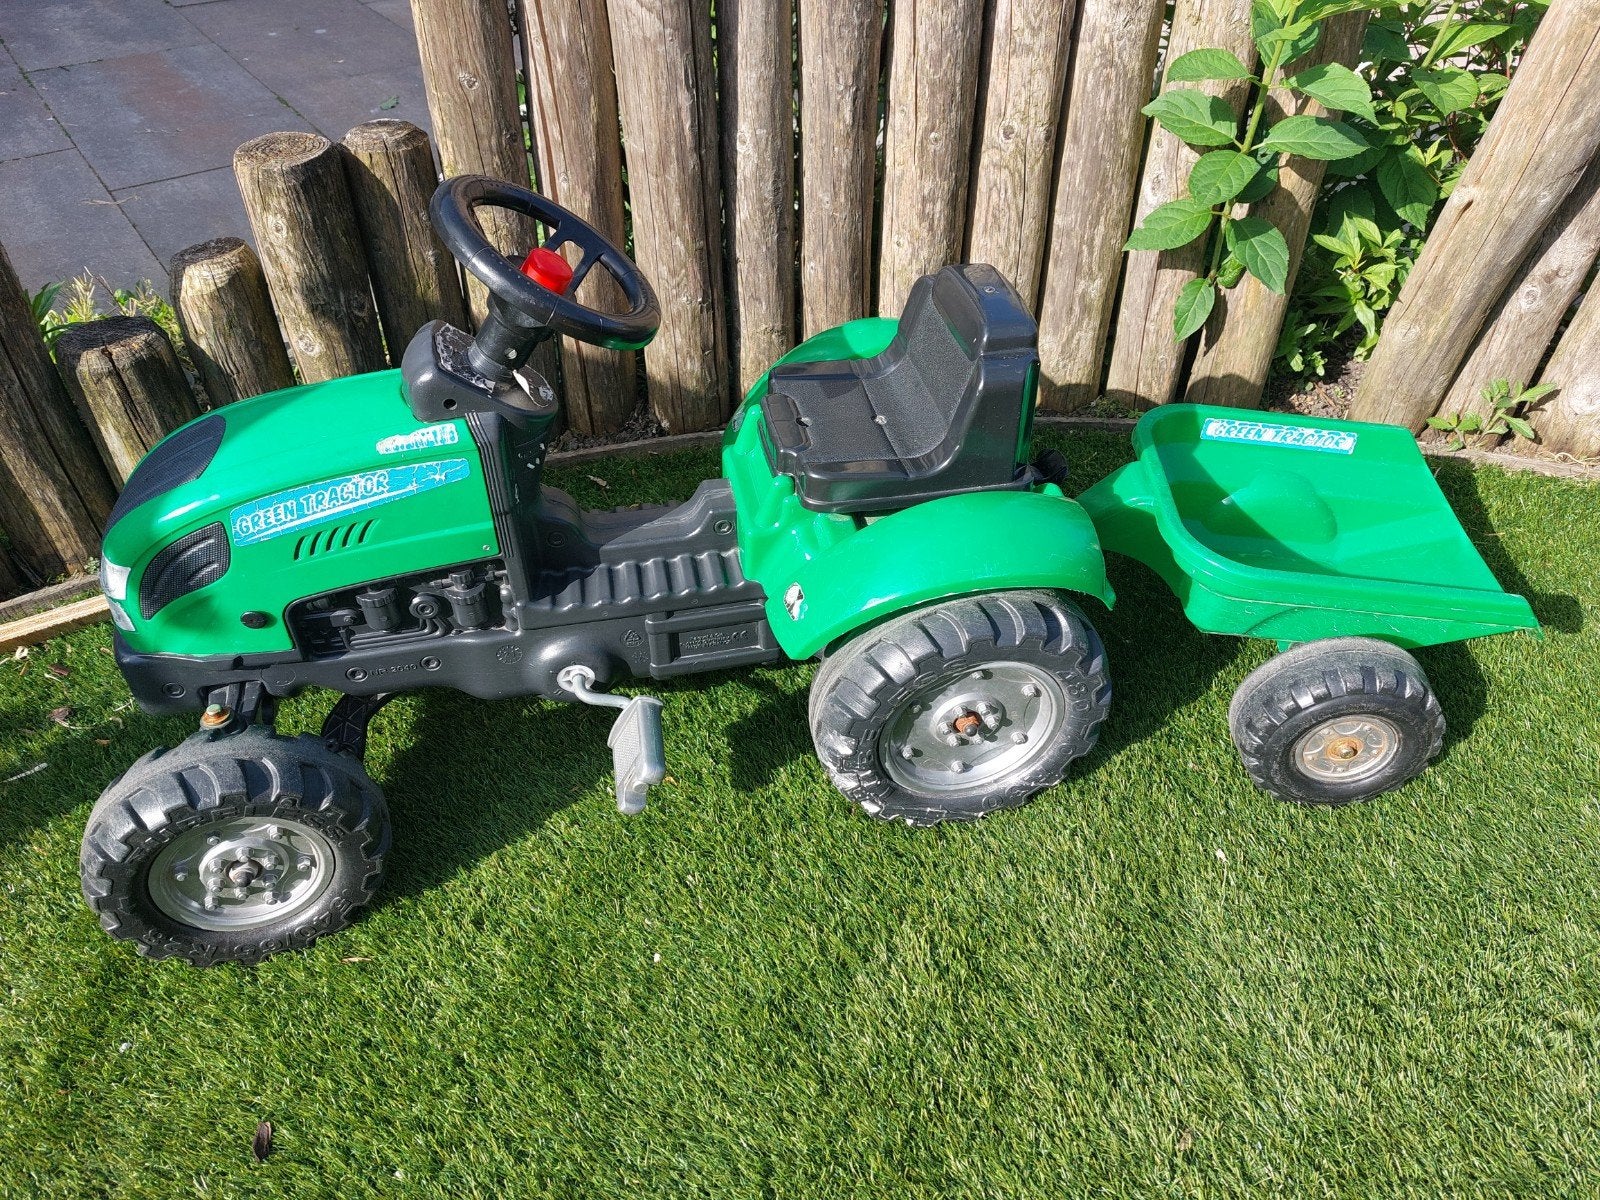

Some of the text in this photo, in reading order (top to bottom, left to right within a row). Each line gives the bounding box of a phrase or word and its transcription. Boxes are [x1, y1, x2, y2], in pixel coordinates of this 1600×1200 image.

[1214, 424, 1346, 448] GREEN TRACTOR
[236, 471, 389, 535] GREEN TRACTOR
